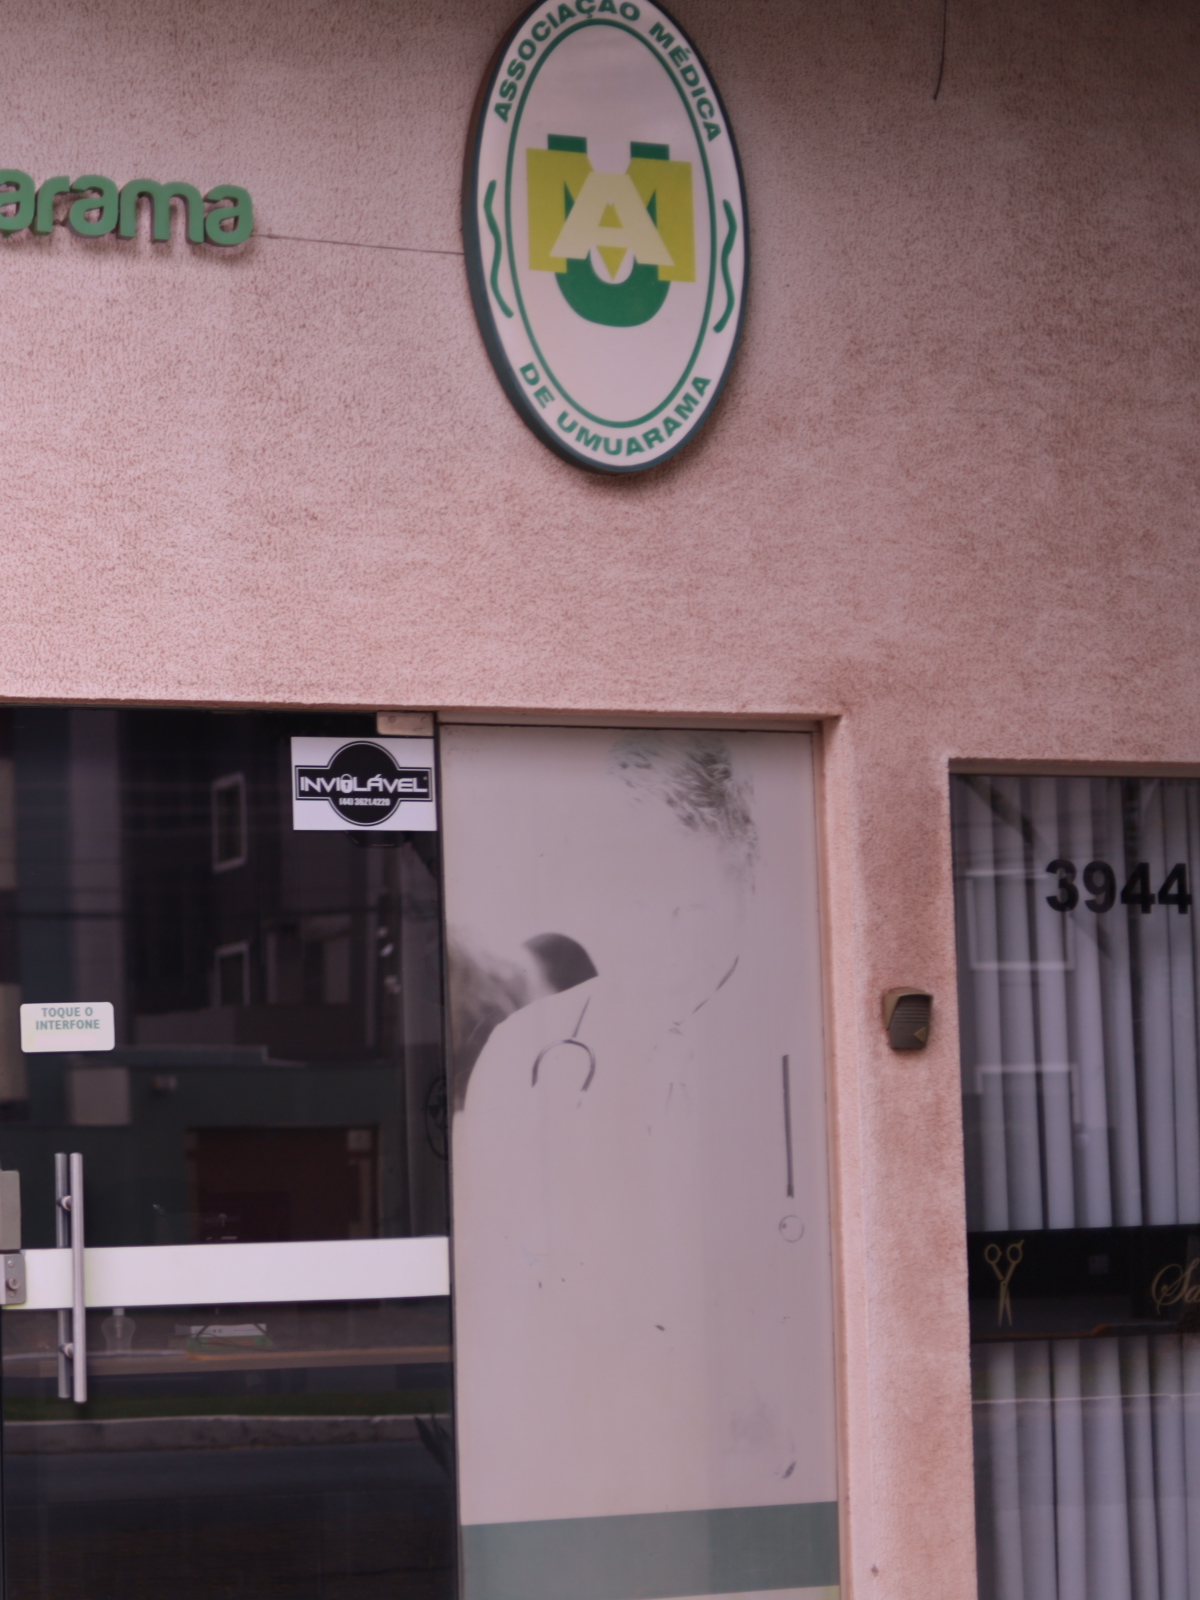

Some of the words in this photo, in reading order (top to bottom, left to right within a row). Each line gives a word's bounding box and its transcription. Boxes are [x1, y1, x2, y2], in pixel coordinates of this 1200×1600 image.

[649, 21, 722, 142] MÉDICA
[519, 362, 555, 409] DE
[556, 376, 712, 456] UMUARAMA
[300, 773, 428, 793] INVIOLÁVEL
[1045, 859, 1193, 915] 3944
[35, 1020, 100, 1030] INTERFONE
[42, 1007, 81, 1018] TOQUE
[84, 1007, 93, 1017] O
